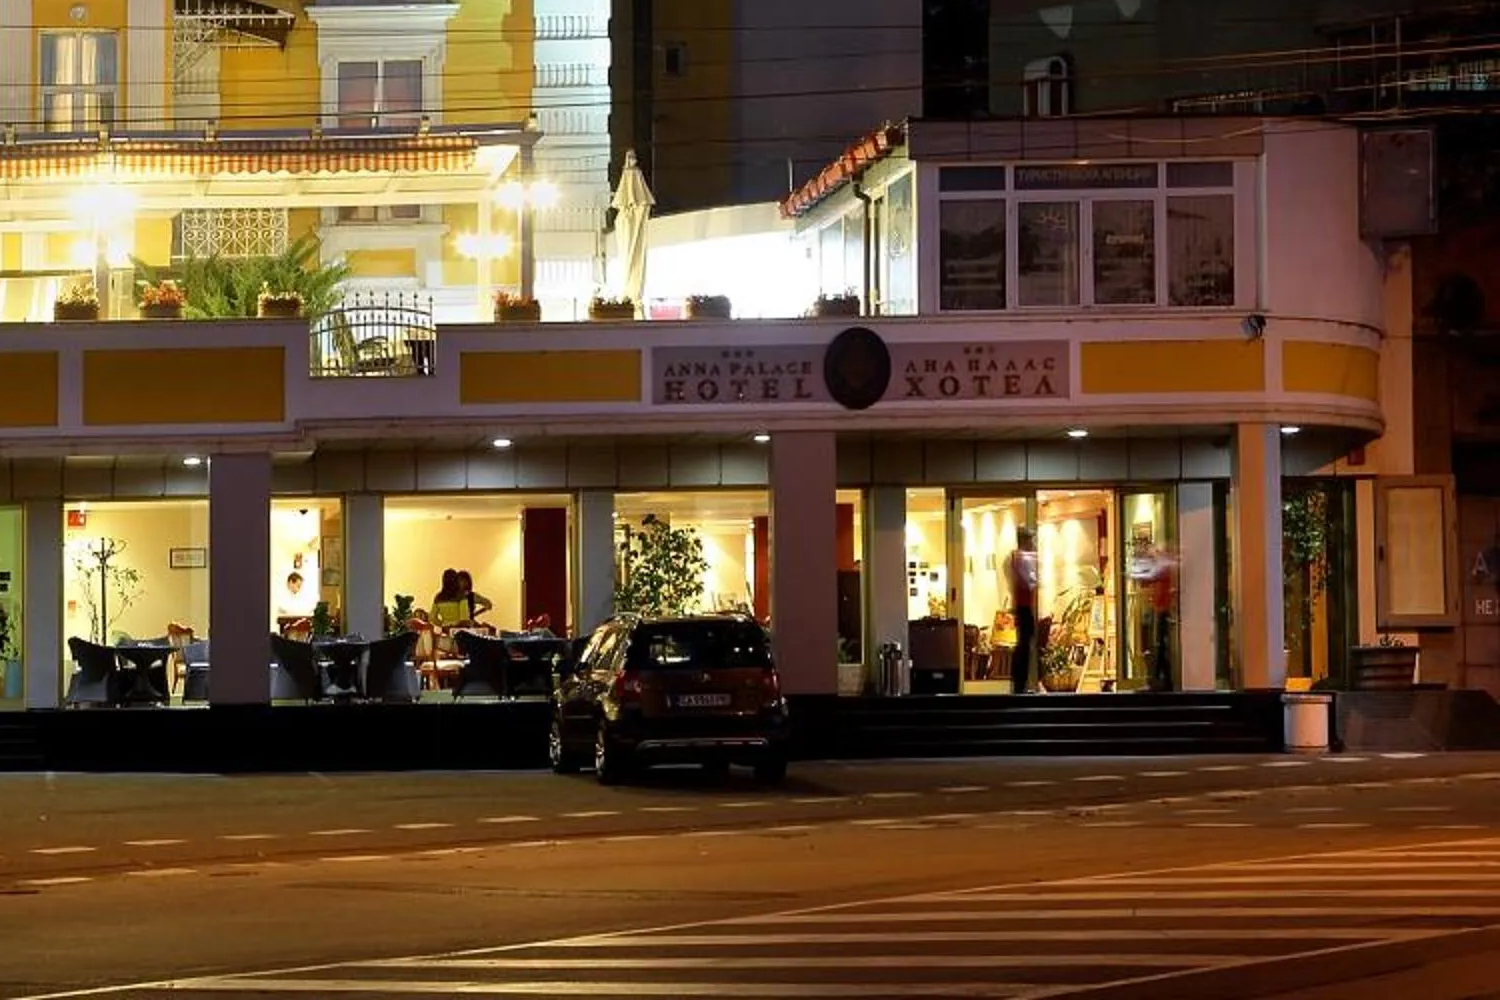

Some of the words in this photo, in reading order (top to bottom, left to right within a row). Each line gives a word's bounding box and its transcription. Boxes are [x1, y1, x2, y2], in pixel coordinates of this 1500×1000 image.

[664, 362, 721, 377] ANNA
[729, 361, 813, 376] PALACE
[664, 378, 813, 401] HOTEL
[905, 375, 1057, 397] ХОТЕЛ
